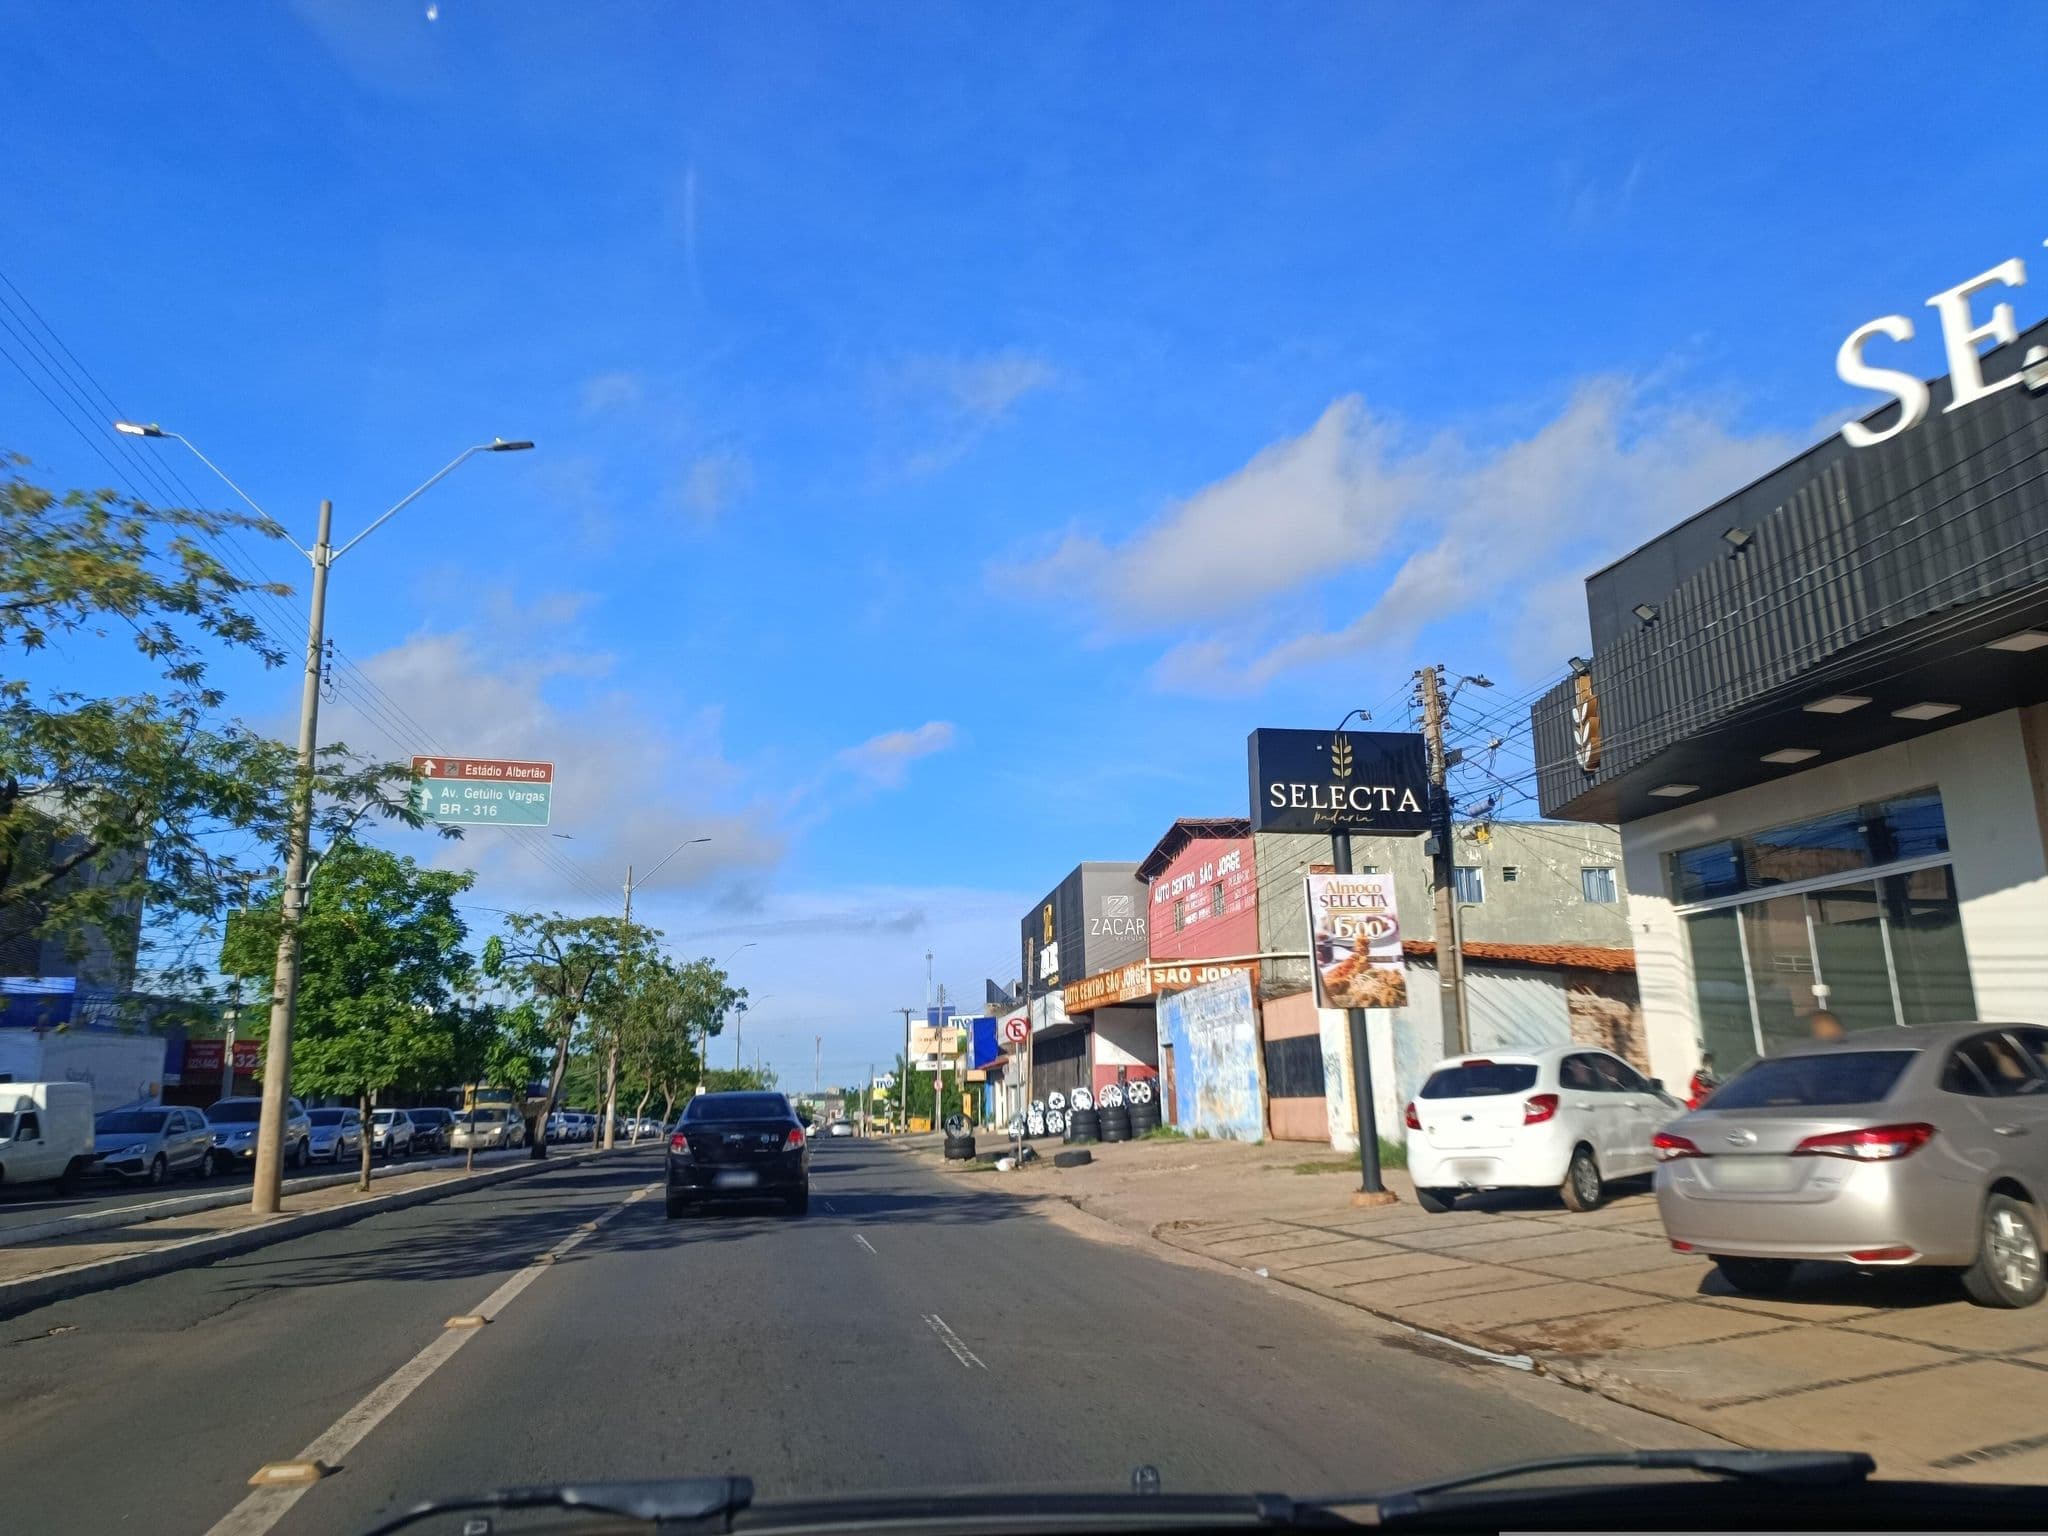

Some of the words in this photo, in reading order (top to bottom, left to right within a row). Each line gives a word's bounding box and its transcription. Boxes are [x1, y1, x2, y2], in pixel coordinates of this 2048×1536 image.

[1836, 240, 2048, 448] SE
[465, 764, 502, 777] Estádio
[505, 767, 546, 779] Albertão
[441, 787, 458, 798] Av.
[464, 787, 503, 800] Getúlio
[508, 790, 545, 804] Vargas
[1270, 783, 1422, 813] SELECTA
[439, 804, 461, 815] BR
[472, 805, 497, 816] 316
[1155, 882, 1170, 905] AUTO
[1171, 871, 1196, 897] CENTRO
[1216, 849, 1241, 877] JORGE
[1319, 894, 1388, 908] SELECTA
[1091, 918, 1146, 935] ZACAR
[1065, 985, 1079, 1006] AUTO
[1080, 977, 1105, 1001] CENTRO
[1121, 964, 1146, 989] JORGE
